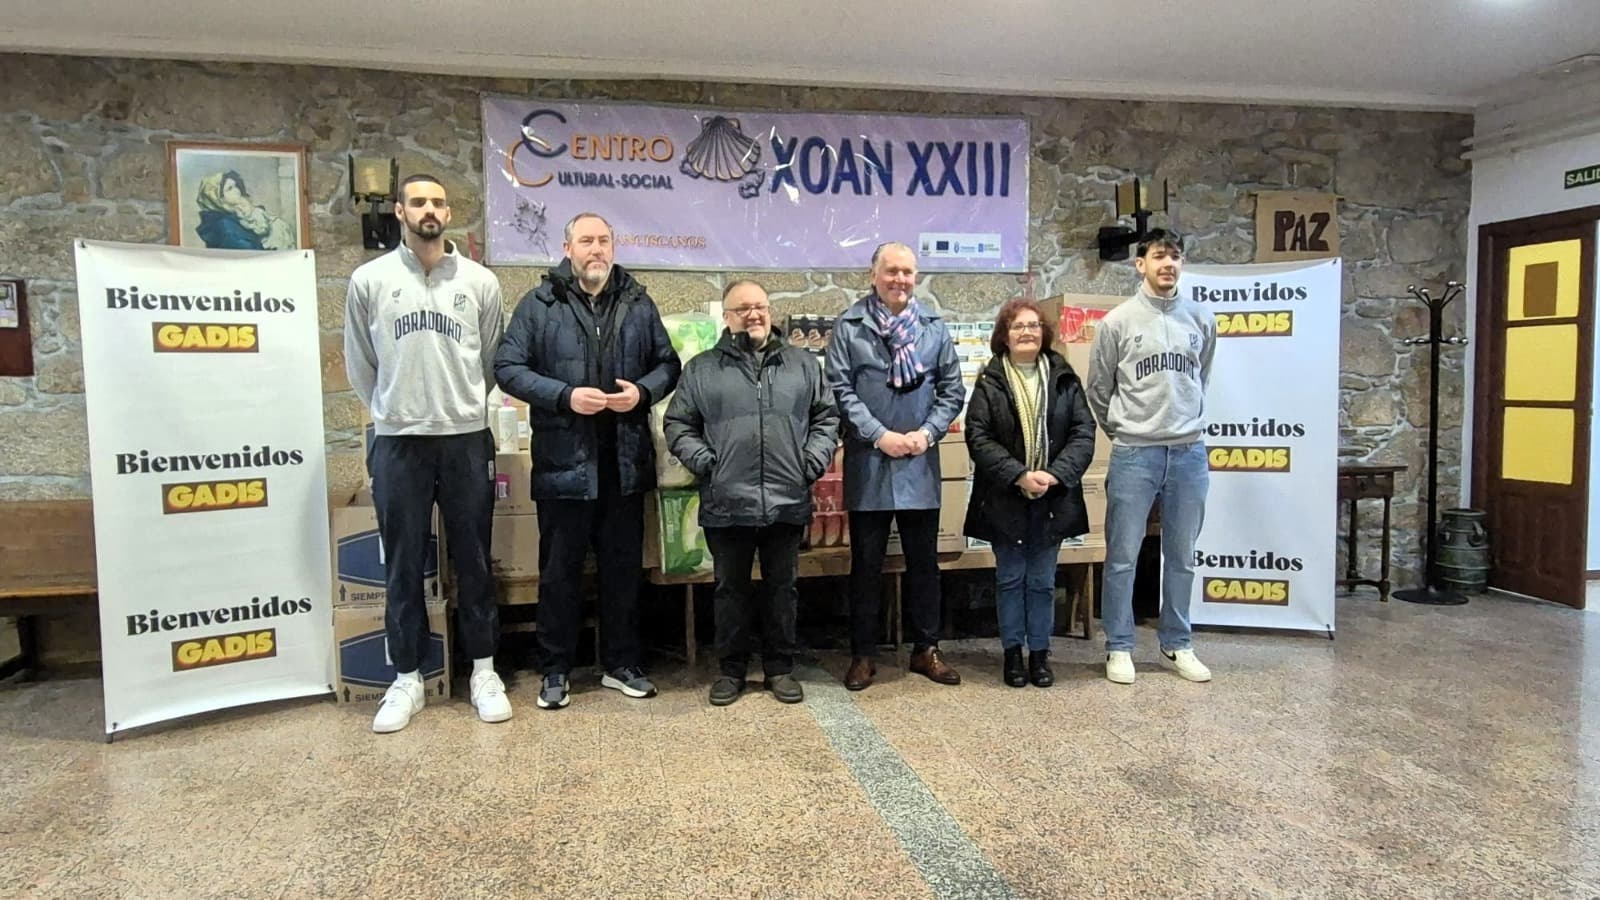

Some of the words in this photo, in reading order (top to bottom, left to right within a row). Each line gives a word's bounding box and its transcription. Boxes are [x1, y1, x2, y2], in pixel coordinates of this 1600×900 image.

[520, 108, 674, 163] CENTRO
[770, 136, 893, 196] XOAN
[906, 141, 1011, 196] XXIII
[1566, 167, 1600, 186] SALID
[1273, 211, 1331, 251] PAZ
[106, 286, 296, 313] Bienvenidos
[1192, 282, 1308, 303] Benvidos
[394, 309, 463, 345] OBRADOIRO
[1215, 312, 1291, 335] GADIS
[157, 324, 257, 350] GADIS
[1201, 417, 1306, 437] envidos
[115, 445, 304, 475] Bienvenidos
[1207, 448, 1288, 469] GADIS
[166, 480, 266, 510] GADIS
[1193, 549, 1304, 572] Benvidos
[1205, 579, 1287, 602] GADIS
[126, 596, 312, 636] Bienvenidos
[175, 630, 274, 665] GADIS
